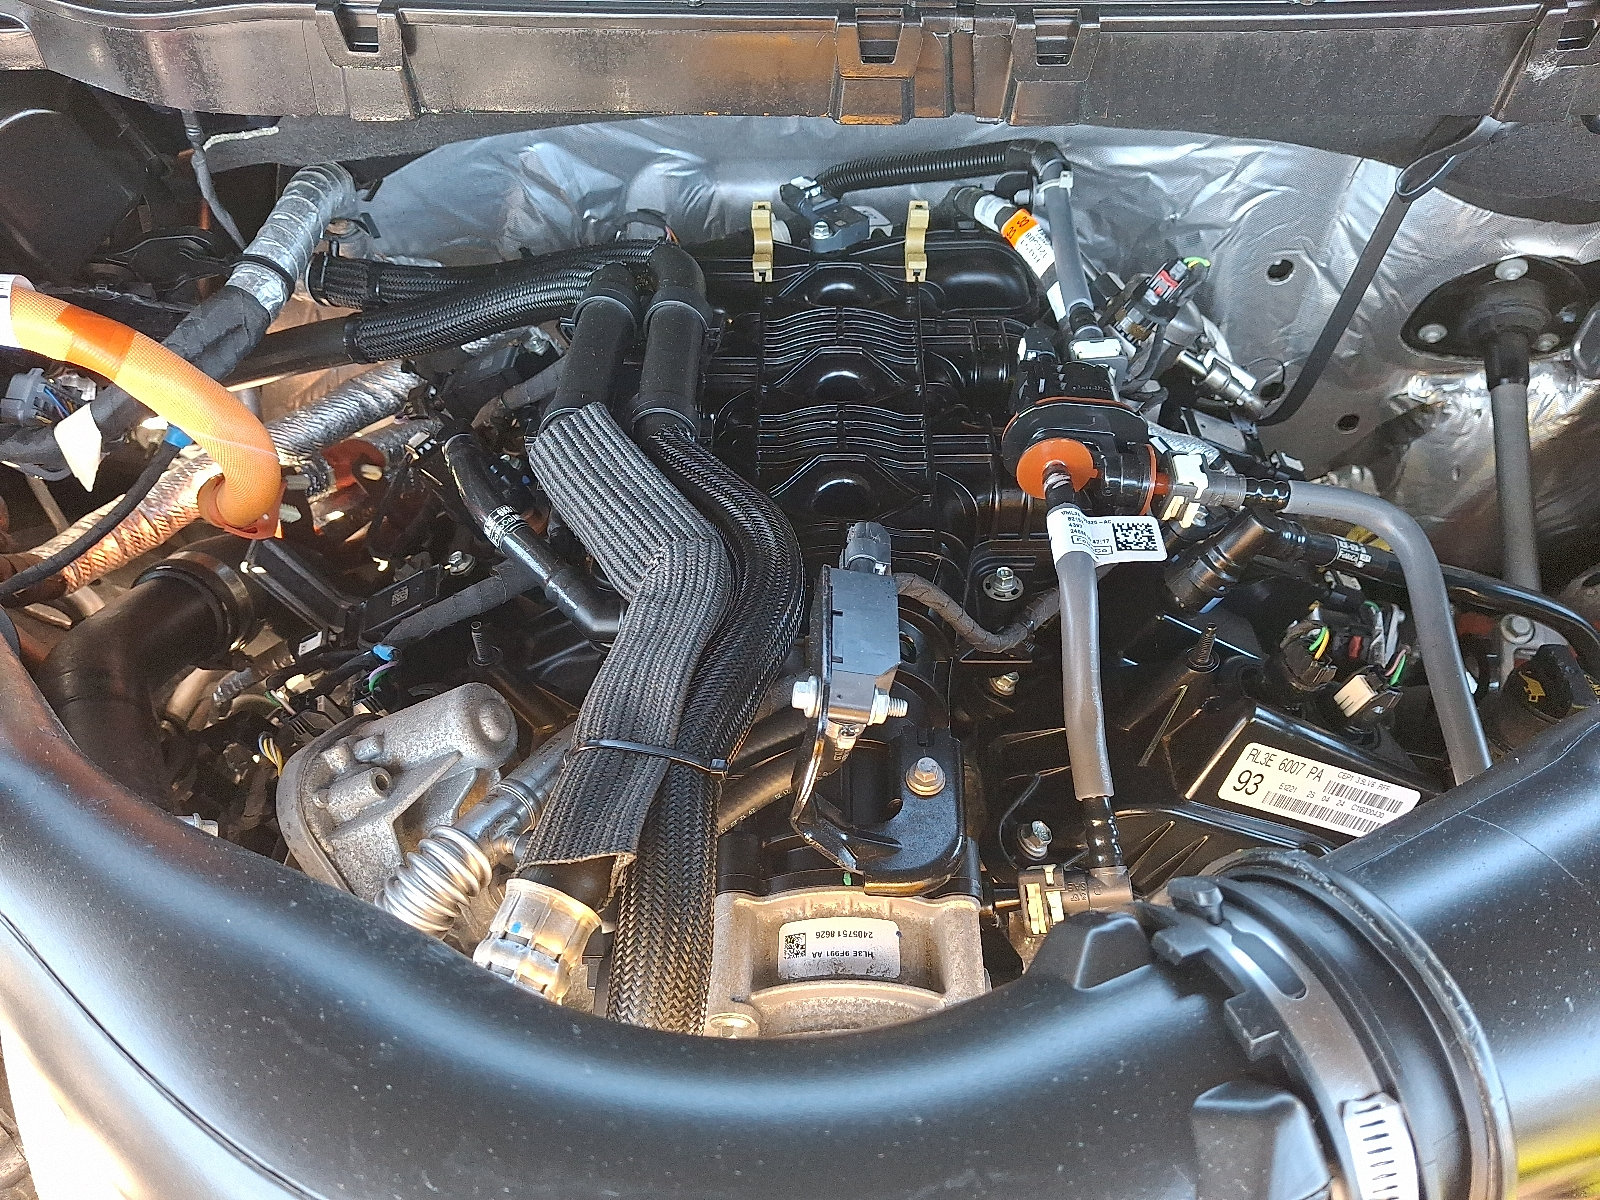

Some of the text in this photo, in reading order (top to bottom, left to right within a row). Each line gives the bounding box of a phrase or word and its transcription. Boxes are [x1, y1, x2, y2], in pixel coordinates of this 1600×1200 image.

[1246, 748, 1325, 782] RL3E 6007 PA
[1232, 769, 1265, 796] 93
[811, 950, 874, 959] HL3E 9F991 AA
